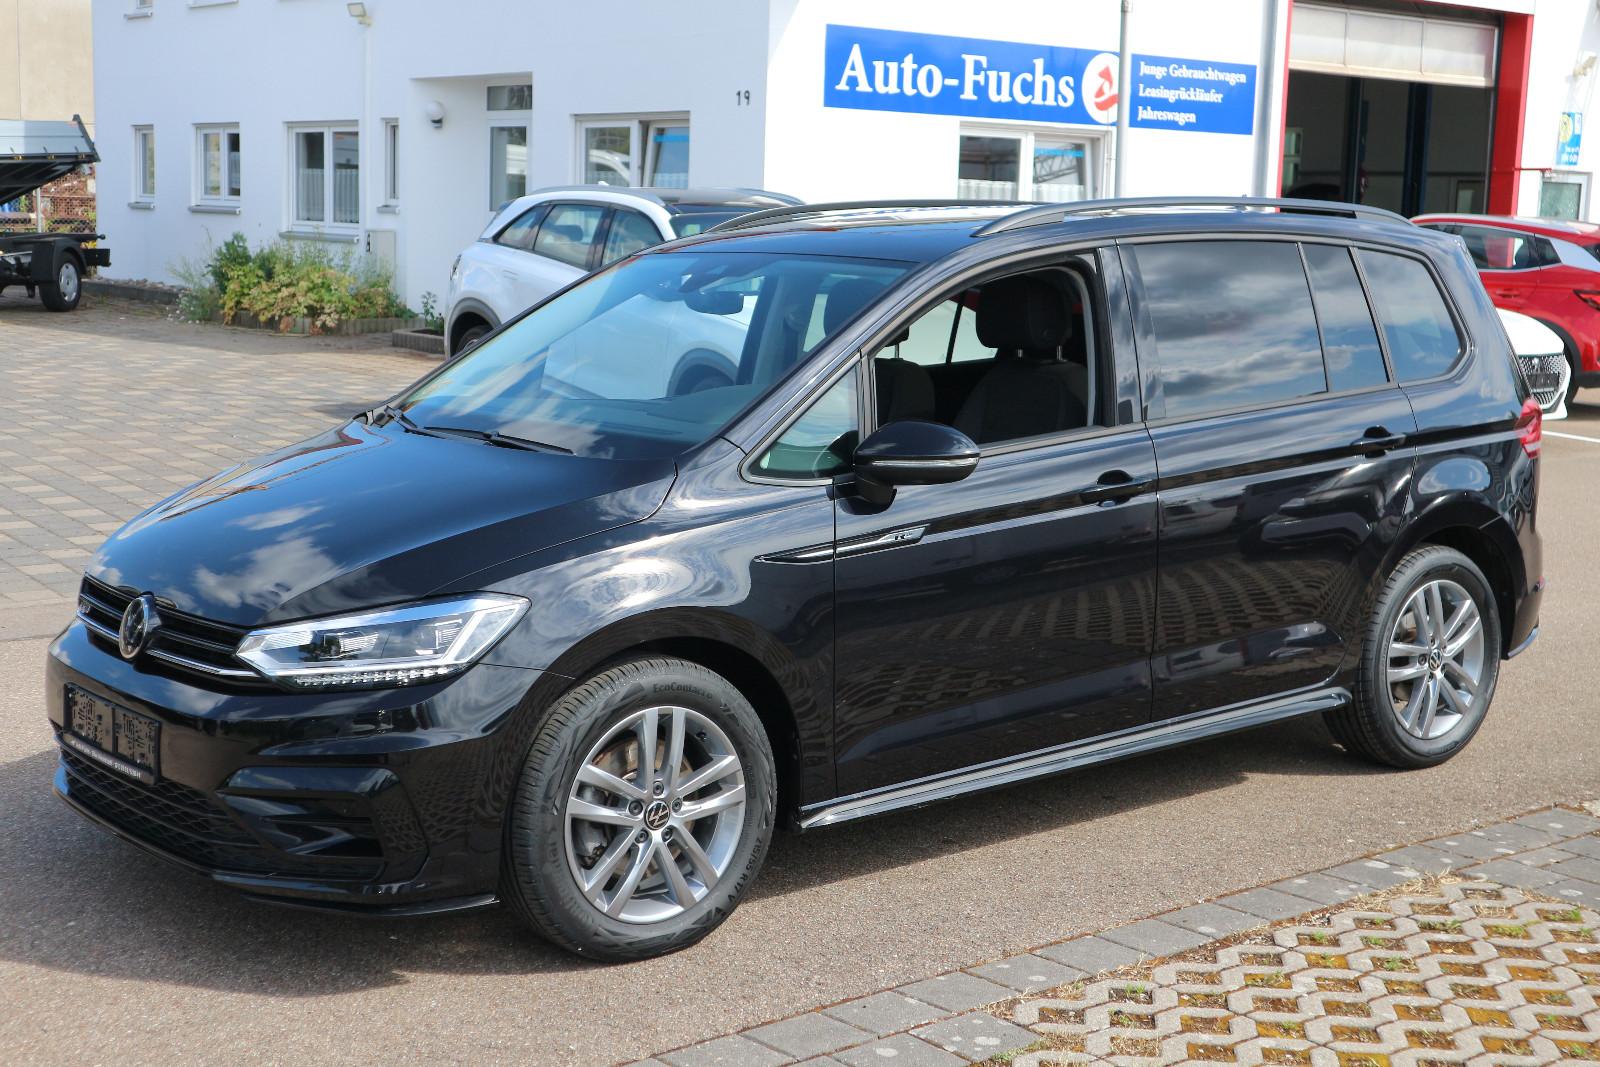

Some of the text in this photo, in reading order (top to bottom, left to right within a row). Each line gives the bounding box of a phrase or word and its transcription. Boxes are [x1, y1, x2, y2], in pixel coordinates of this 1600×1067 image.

[835, 43, 1075, 108] Auto-Fuchs
[1139, 61, 1247, 86] Junge Gebrauchtwagen
[735, 90, 751, 106] 19
[1138, 83, 1224, 104] Leasingrückläufer
[1137, 106, 1197, 126] Jahreswagen
